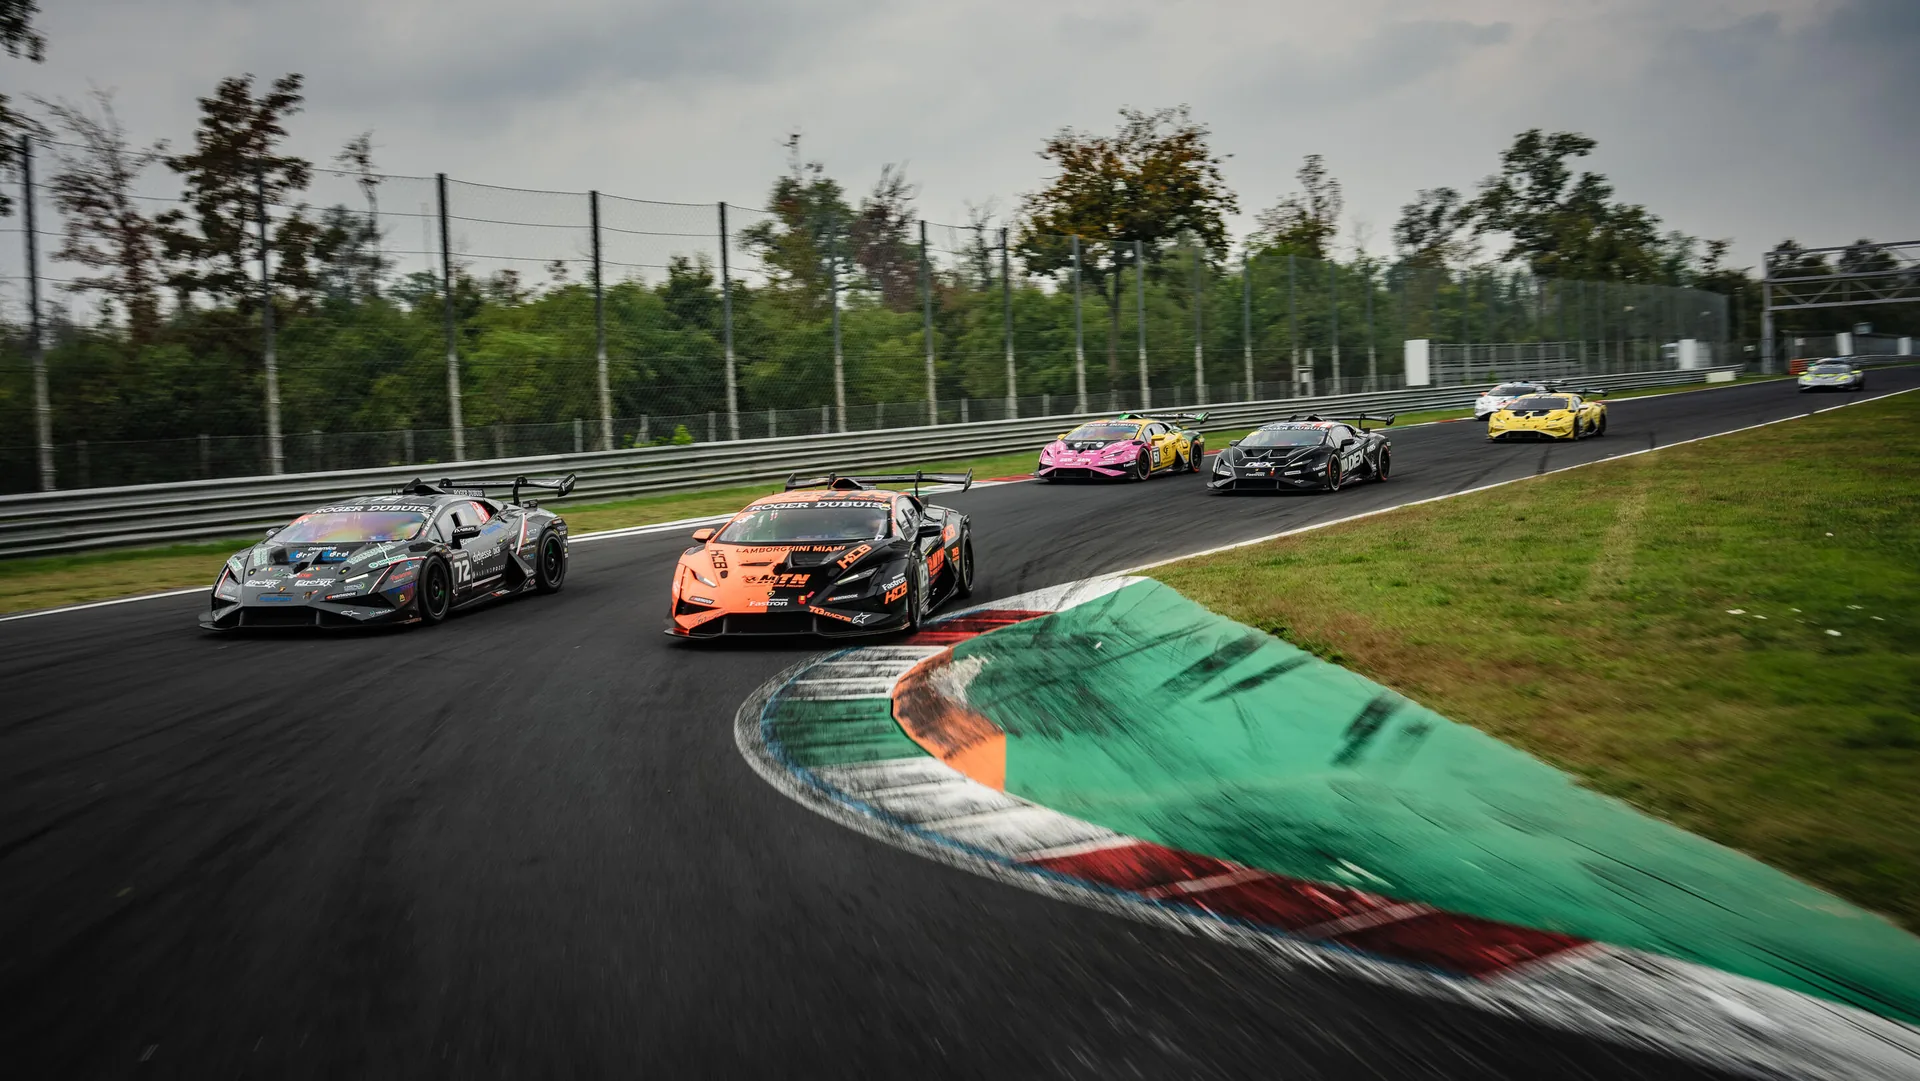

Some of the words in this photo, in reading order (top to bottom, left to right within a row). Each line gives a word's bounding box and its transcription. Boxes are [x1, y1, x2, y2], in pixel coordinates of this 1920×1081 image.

[312, 505, 364, 515] ROGER
[750, 502, 809, 511] ROGER
[736, 545, 810, 554] LAMBORGHINI
[812, 545, 846, 553] MIAMI
[453, 560, 471, 583] 72
